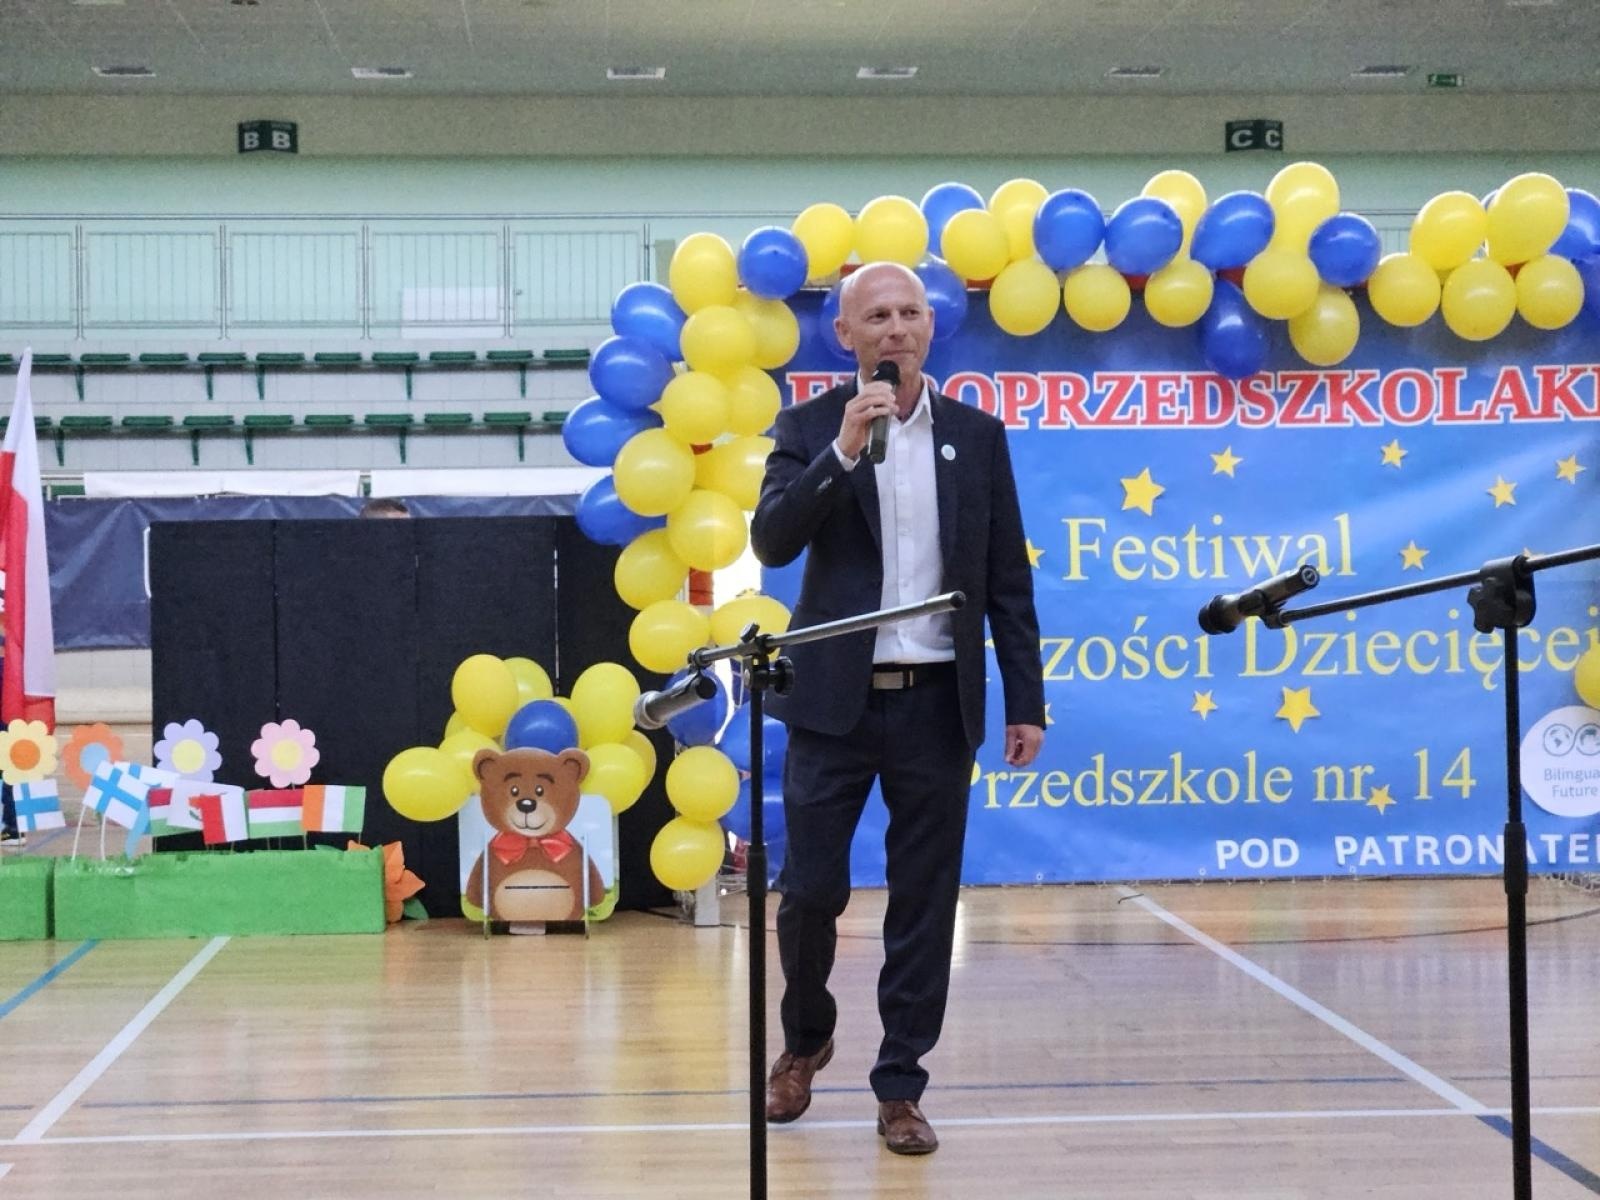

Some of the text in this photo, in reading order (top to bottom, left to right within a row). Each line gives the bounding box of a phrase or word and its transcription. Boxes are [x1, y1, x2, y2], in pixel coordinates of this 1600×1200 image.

[244, 132, 260, 150] B
[272, 130, 291, 149] B
[1231, 129, 1253, 147] C
[1265, 129, 1280, 147] C
[786, 364, 1600, 429] OPRZEDSZKOLAK
[1062, 513, 1357, 582] Festiwal
[1413, 747, 1476, 800] 14
[1552, 785, 1598, 798] Future
[1216, 834, 1600, 869] POD PATRONTE
